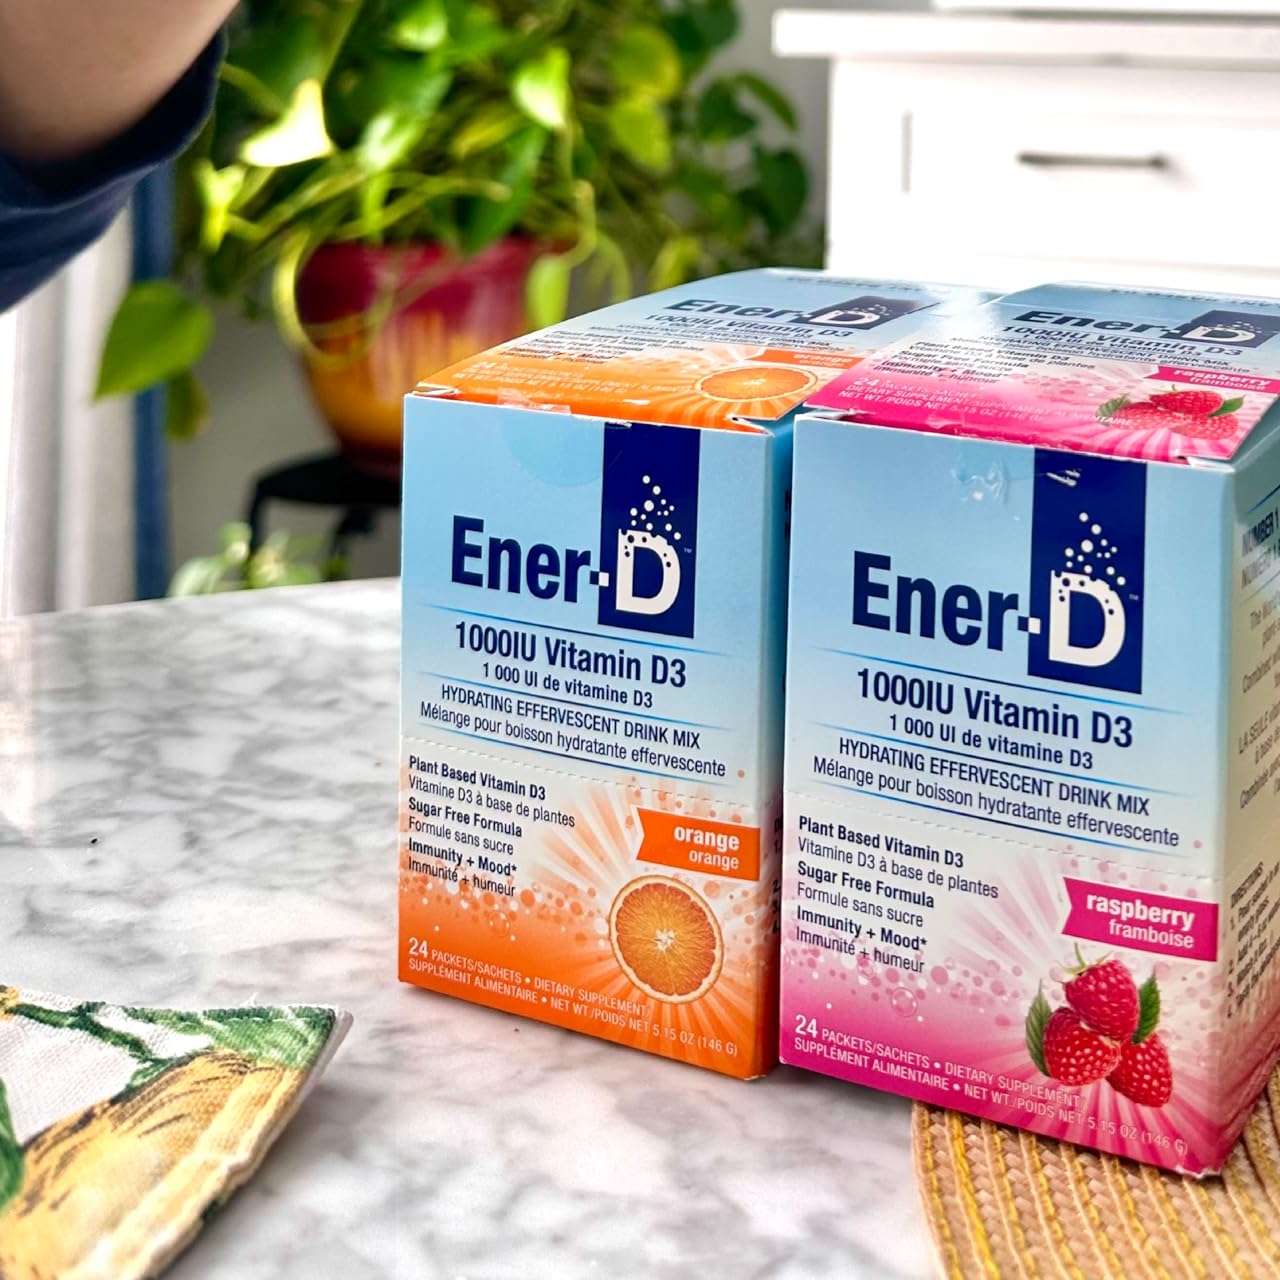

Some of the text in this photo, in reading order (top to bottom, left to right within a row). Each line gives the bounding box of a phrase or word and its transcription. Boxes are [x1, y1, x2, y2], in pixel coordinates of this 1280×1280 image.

[665, 299, 880, 325] Ener-D
[725, 320, 813, 334] Vitamin
[818, 329, 854, 338] D3
[1012, 310, 1256, 342] Ener-D
[1003, 326, 1243, 356] 1000IU Vitamin D3
[838, 390, 862, 399] NET
[924, 402, 947, 410] NET
[846, 385, 890, 396] DIETARY
[854, 377, 878, 387] 24
[1173, 369, 1271, 386] raspberry
[452, 515, 681, 615] Ener-D
[852, 550, 1126, 667] Ener-D
[456, 622, 686, 688] 1000IU Vitamin D3
[483, 662, 653, 708] 1 000 UI de vitamine D3
[858, 668, 1132, 748] 1000IU Vitamin D3
[421, 701, 726, 777] Mélange pour boisson hydratante effervescente
[442, 684, 700, 750] HYDRATING EFFERVESCENT DRINK MIX
[890, 714, 1093, 770] 1 000 UI de vitamine D3
[409, 755, 546, 800] Plant Based Vitamin D3
[839, 737, 1149, 816] HYDRATING EFFERVESCENT DRINK MIX
[408, 775, 575, 827] Vitamine D3 à base de plantes
[409, 796, 522, 837] Sugar Free Formula
[814, 755, 1179, 847] Mélange pour boisson hydratante effervescente
[409, 816, 514, 855] Formule sans sucre
[409, 837, 462, 867] Immunity
[674, 826, 740, 852] orange
[799, 815, 963, 868] Plant Based Vitamin D3
[409, 856, 458, 882] Immunité
[473, 875, 516, 896] humeur
[689, 850, 739, 871] orange
[798, 836, 998, 899] Vitamine D3 à base de plantes
[797, 881, 923, 927] Formule sans sucre
[798, 860, 934, 908] Sugar Free Formula
[797, 905, 862, 939] Immunity
[1087, 894, 1195, 932] raspberry
[1109, 919, 1194, 949] framboise
[409, 937, 428, 958] 24
[431, 949, 521, 984] PACKETS/SACHETS
[534, 977, 575, 997] DIETARY
[796, 926, 855, 955] Immunité
[874, 946, 925, 973] humeur
[409, 958, 471, 984] SUPPLÉMENT
[474, 976, 538, 1003] ALIMENTAIRE
[551, 997, 569, 1011] NET
[629, 1018, 649, 1033] NET
[653, 1024, 676, 1041] 5.15
[680, 1031, 694, 1046] OZ
[698, 1035, 723, 1052] (146
[726, 1043, 737, 1057] G)
[794, 1014, 818, 1038] 24
[822, 1028, 930, 1069] PACKETS/SACHETS
[945, 1062, 994, 1085] DIETARY
[794, 1037, 870, 1068] SUPPLÉMENT
[872, 1059, 949, 1091] ALIMENTAIRE
[964, 1083, 987, 1099] NET
[1058, 1108, 1083, 1125] NET
[1087, 1116, 1116, 1135] 5.15
[1120, 1125, 1137, 1140] OZ
[1141, 1131, 1170, 1149] (146
[1174, 1138, 1188, 1155] G)
